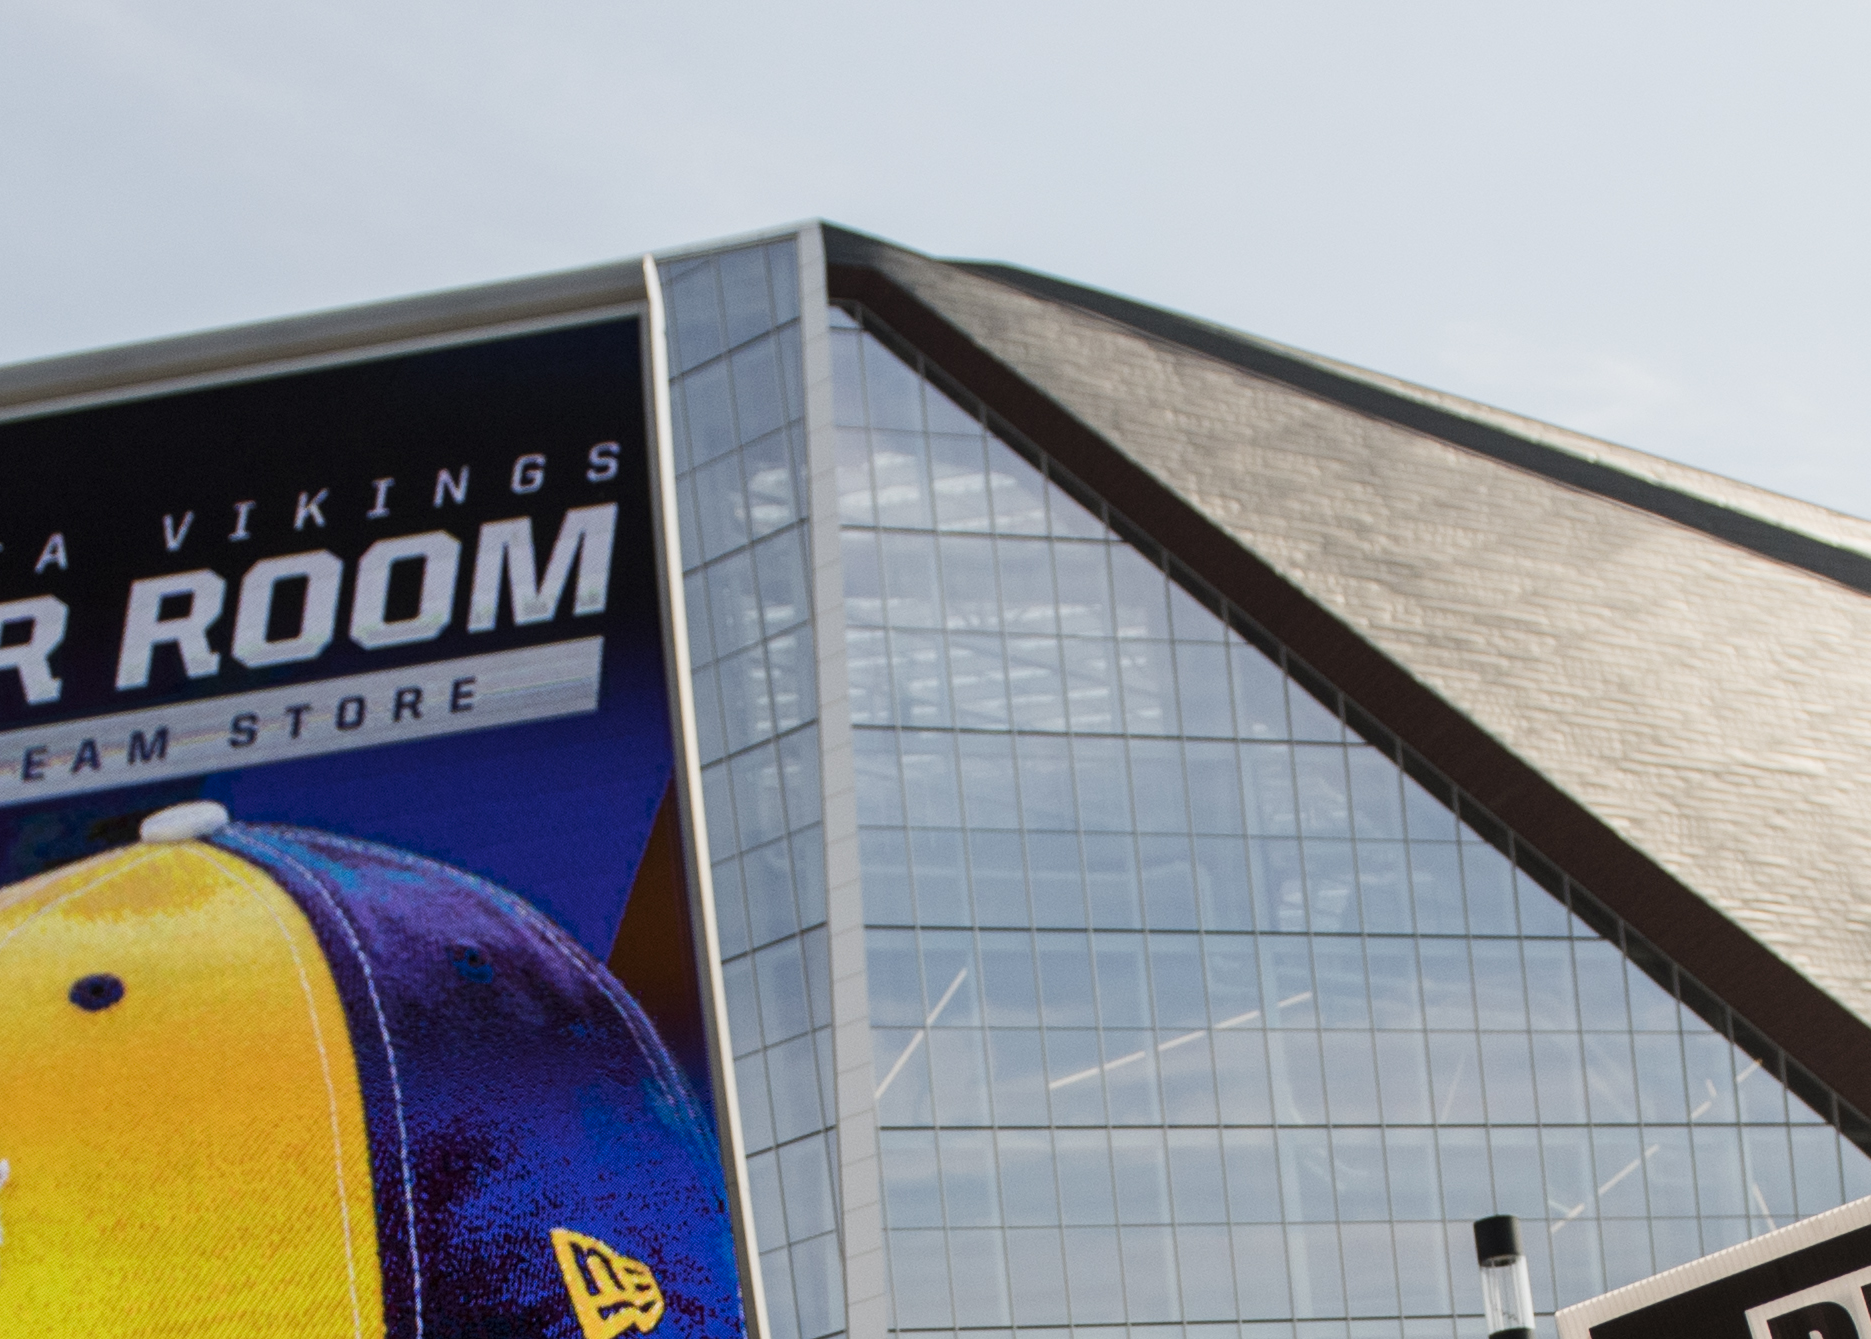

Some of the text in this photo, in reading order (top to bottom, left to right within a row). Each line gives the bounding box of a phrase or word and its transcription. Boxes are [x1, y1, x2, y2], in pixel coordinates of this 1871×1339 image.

[161, 440, 620, 551] VIKINGS
[114, 500, 620, 692] ROOM
[228, 673, 481, 748] STORE
